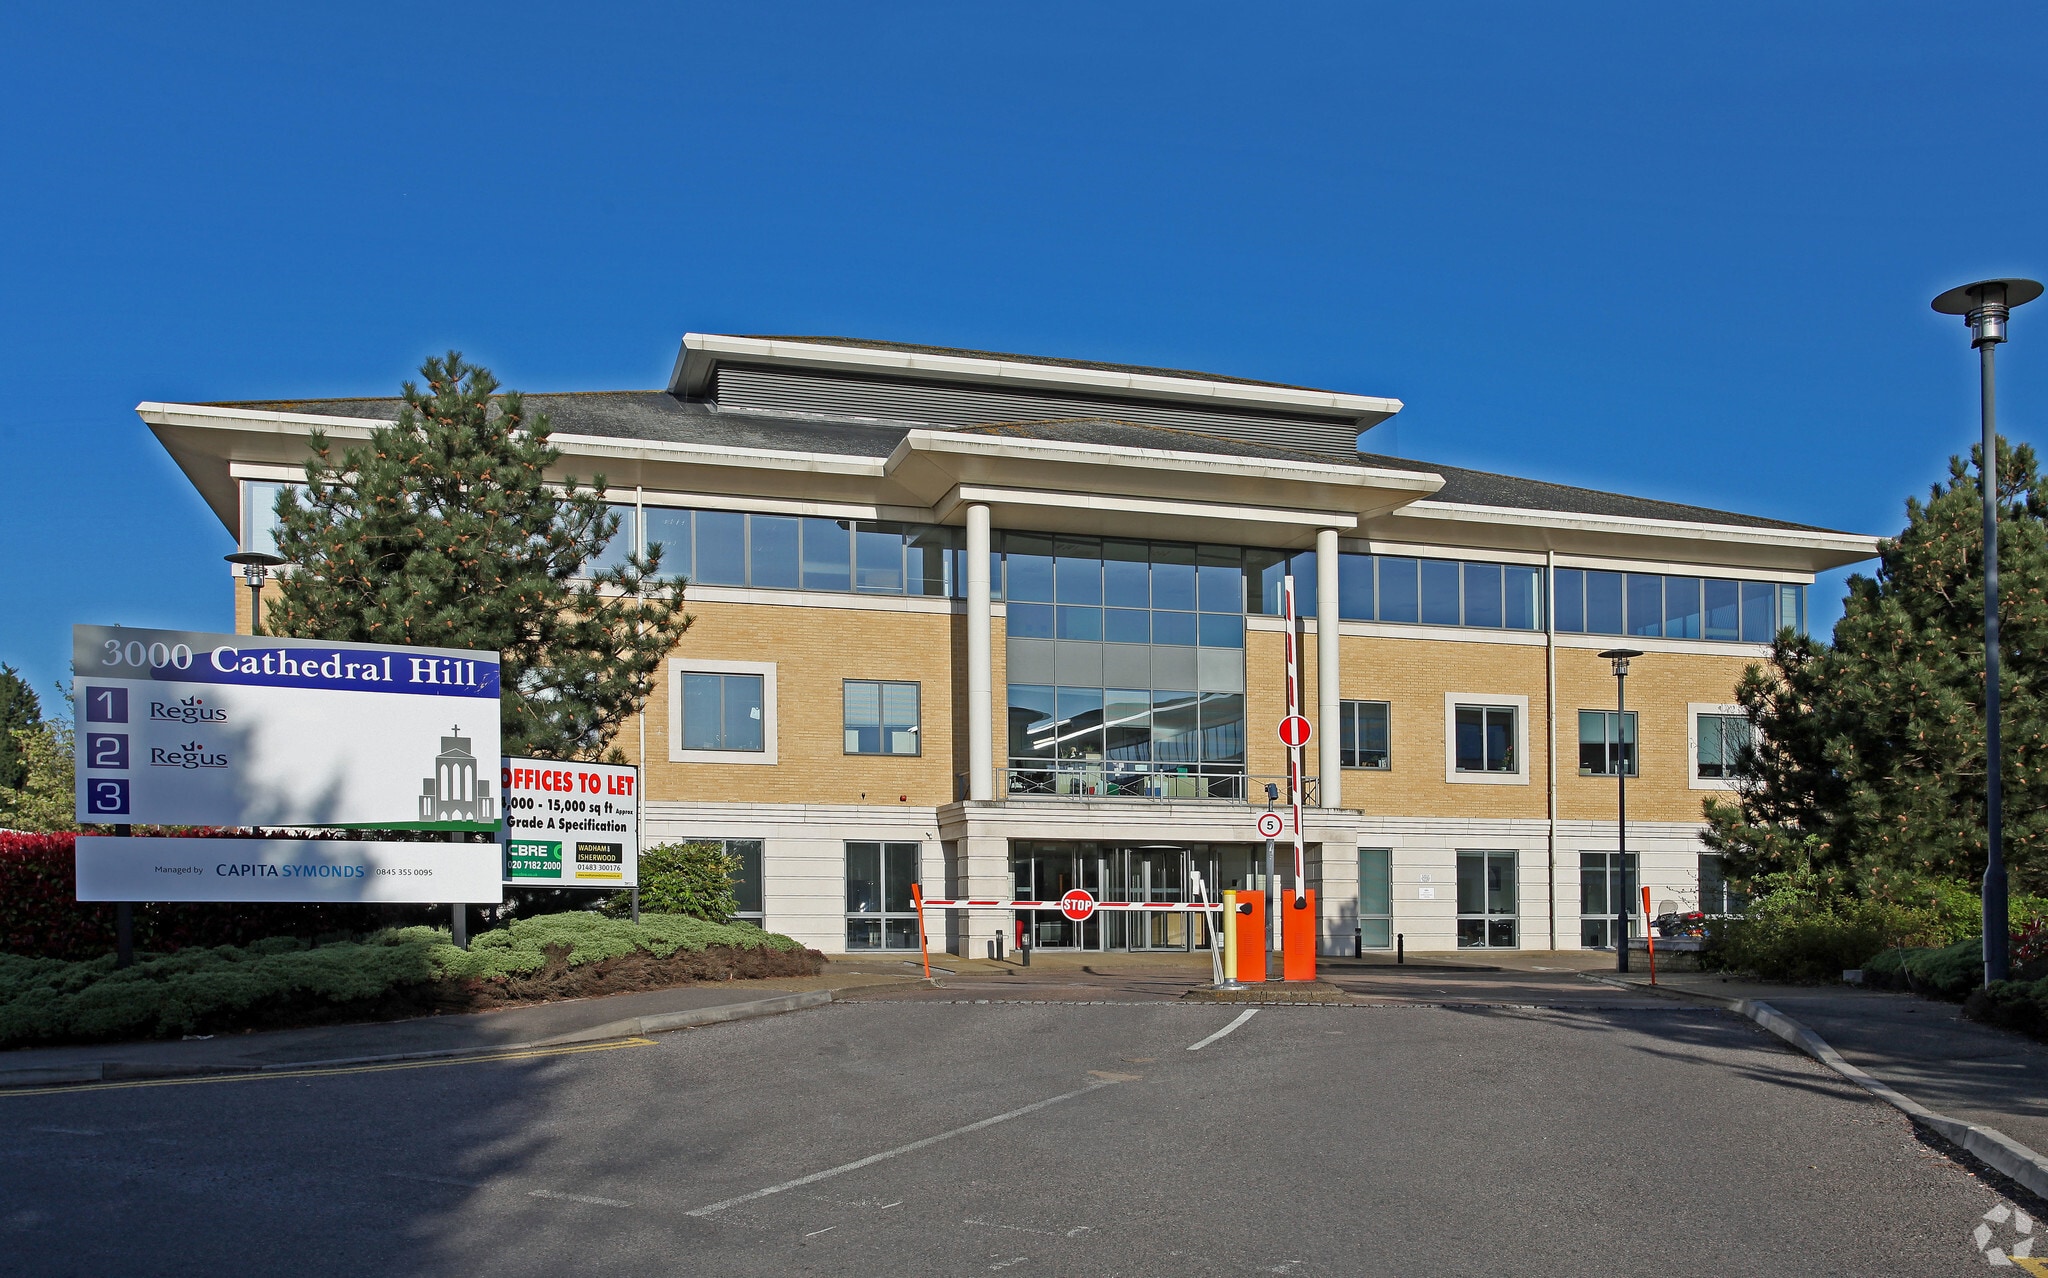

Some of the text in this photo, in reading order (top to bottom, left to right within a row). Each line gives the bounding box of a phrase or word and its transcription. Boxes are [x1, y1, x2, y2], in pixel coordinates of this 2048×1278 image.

[102, 639, 477, 686] 3000 Cathedral Hill
[97, 691, 228, 724] 1 Regus
[96, 737, 228, 769] 2 Regus
[502, 767, 634, 796] OFFICES TO LET
[96, 782, 121, 811] 3
[547, 799, 586, 814] 15,000
[589, 803, 601, 816] sq
[604, 801, 613, 814] ft
[615, 808, 634, 816] Approx
[506, 815, 627, 833] Grade A Specification
[1266, 820, 1274, 831] 5
[507, 844, 548, 857] CBRE
[578, 844, 607, 853] WADHAM
[578, 853, 616, 862] ISHERWOOD
[154, 863, 433, 878] Managed by CAPITA SYMONDS 0845 355 0095
[507, 860, 561, 871] 020 7182 2000
[577, 863, 621, 872] 01483 300176
[1063, 899, 1092, 911] STOP
